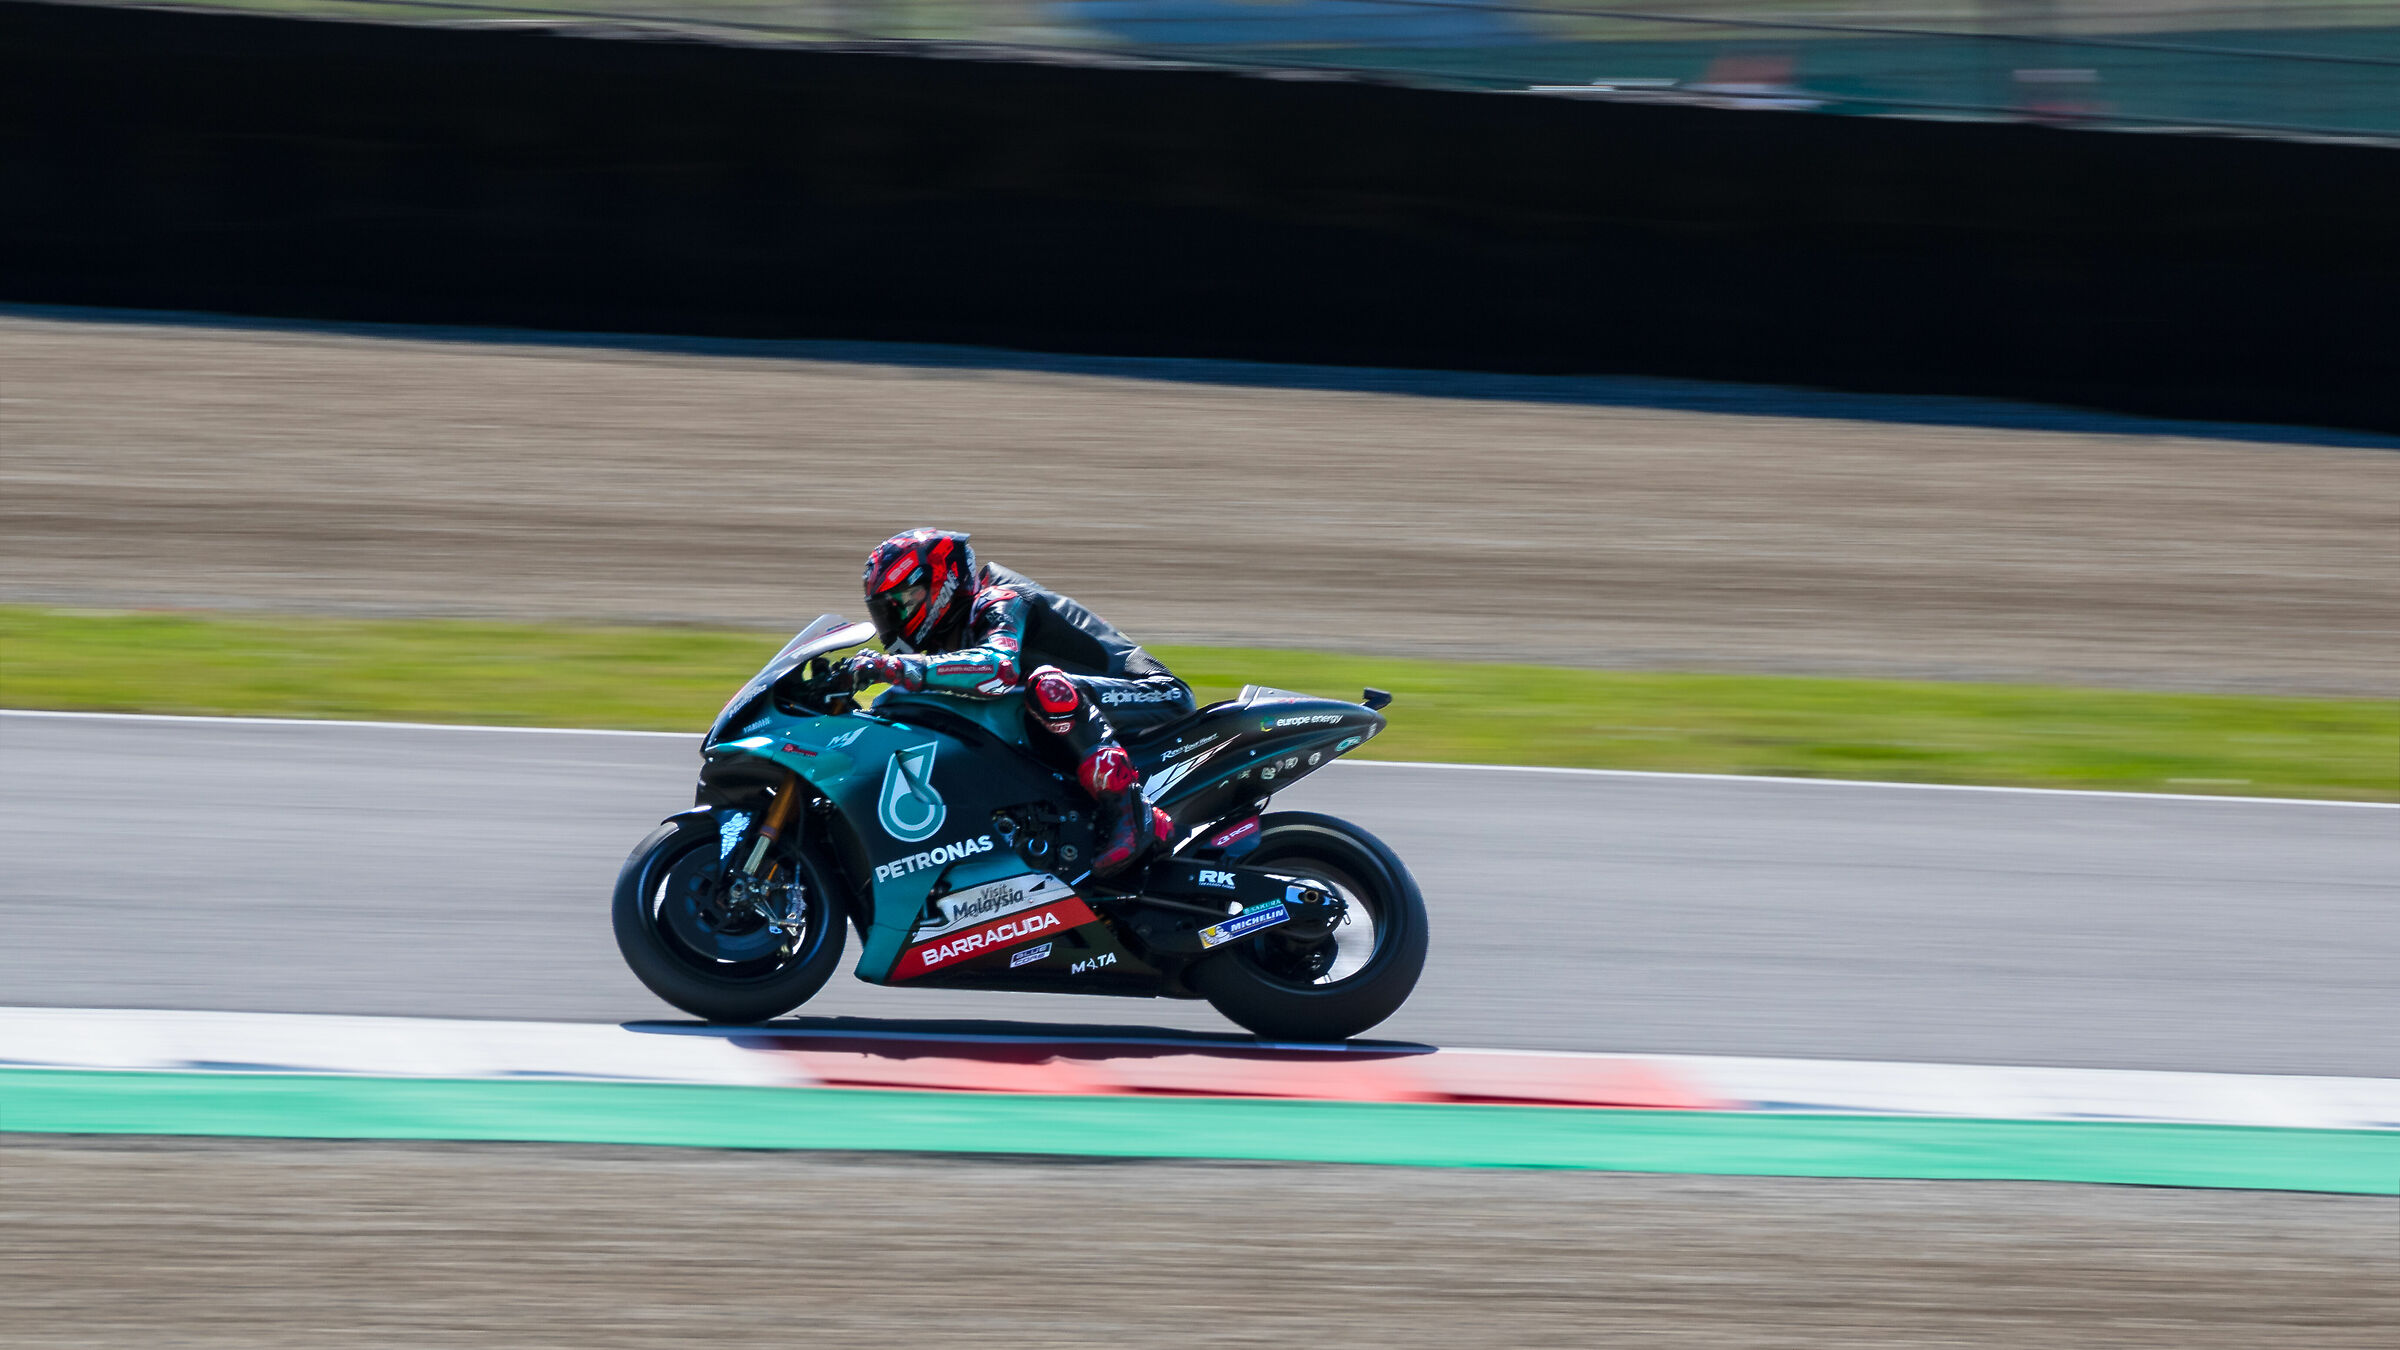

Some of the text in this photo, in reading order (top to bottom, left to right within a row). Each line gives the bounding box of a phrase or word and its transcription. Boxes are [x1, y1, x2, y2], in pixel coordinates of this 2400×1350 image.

[1101, 687, 1182, 706] alpinestars
[1276, 714, 1344, 727] europe energy
[875, 835, 994, 883] PETRONAS
[1199, 870, 1236, 887] RK
[981, 884, 1007, 900] Visit
[953, 889, 1024, 920] Malaysia
[1231, 909, 1284, 932] MICHELIN
[922, 912, 1060, 966] BARRACUDA
